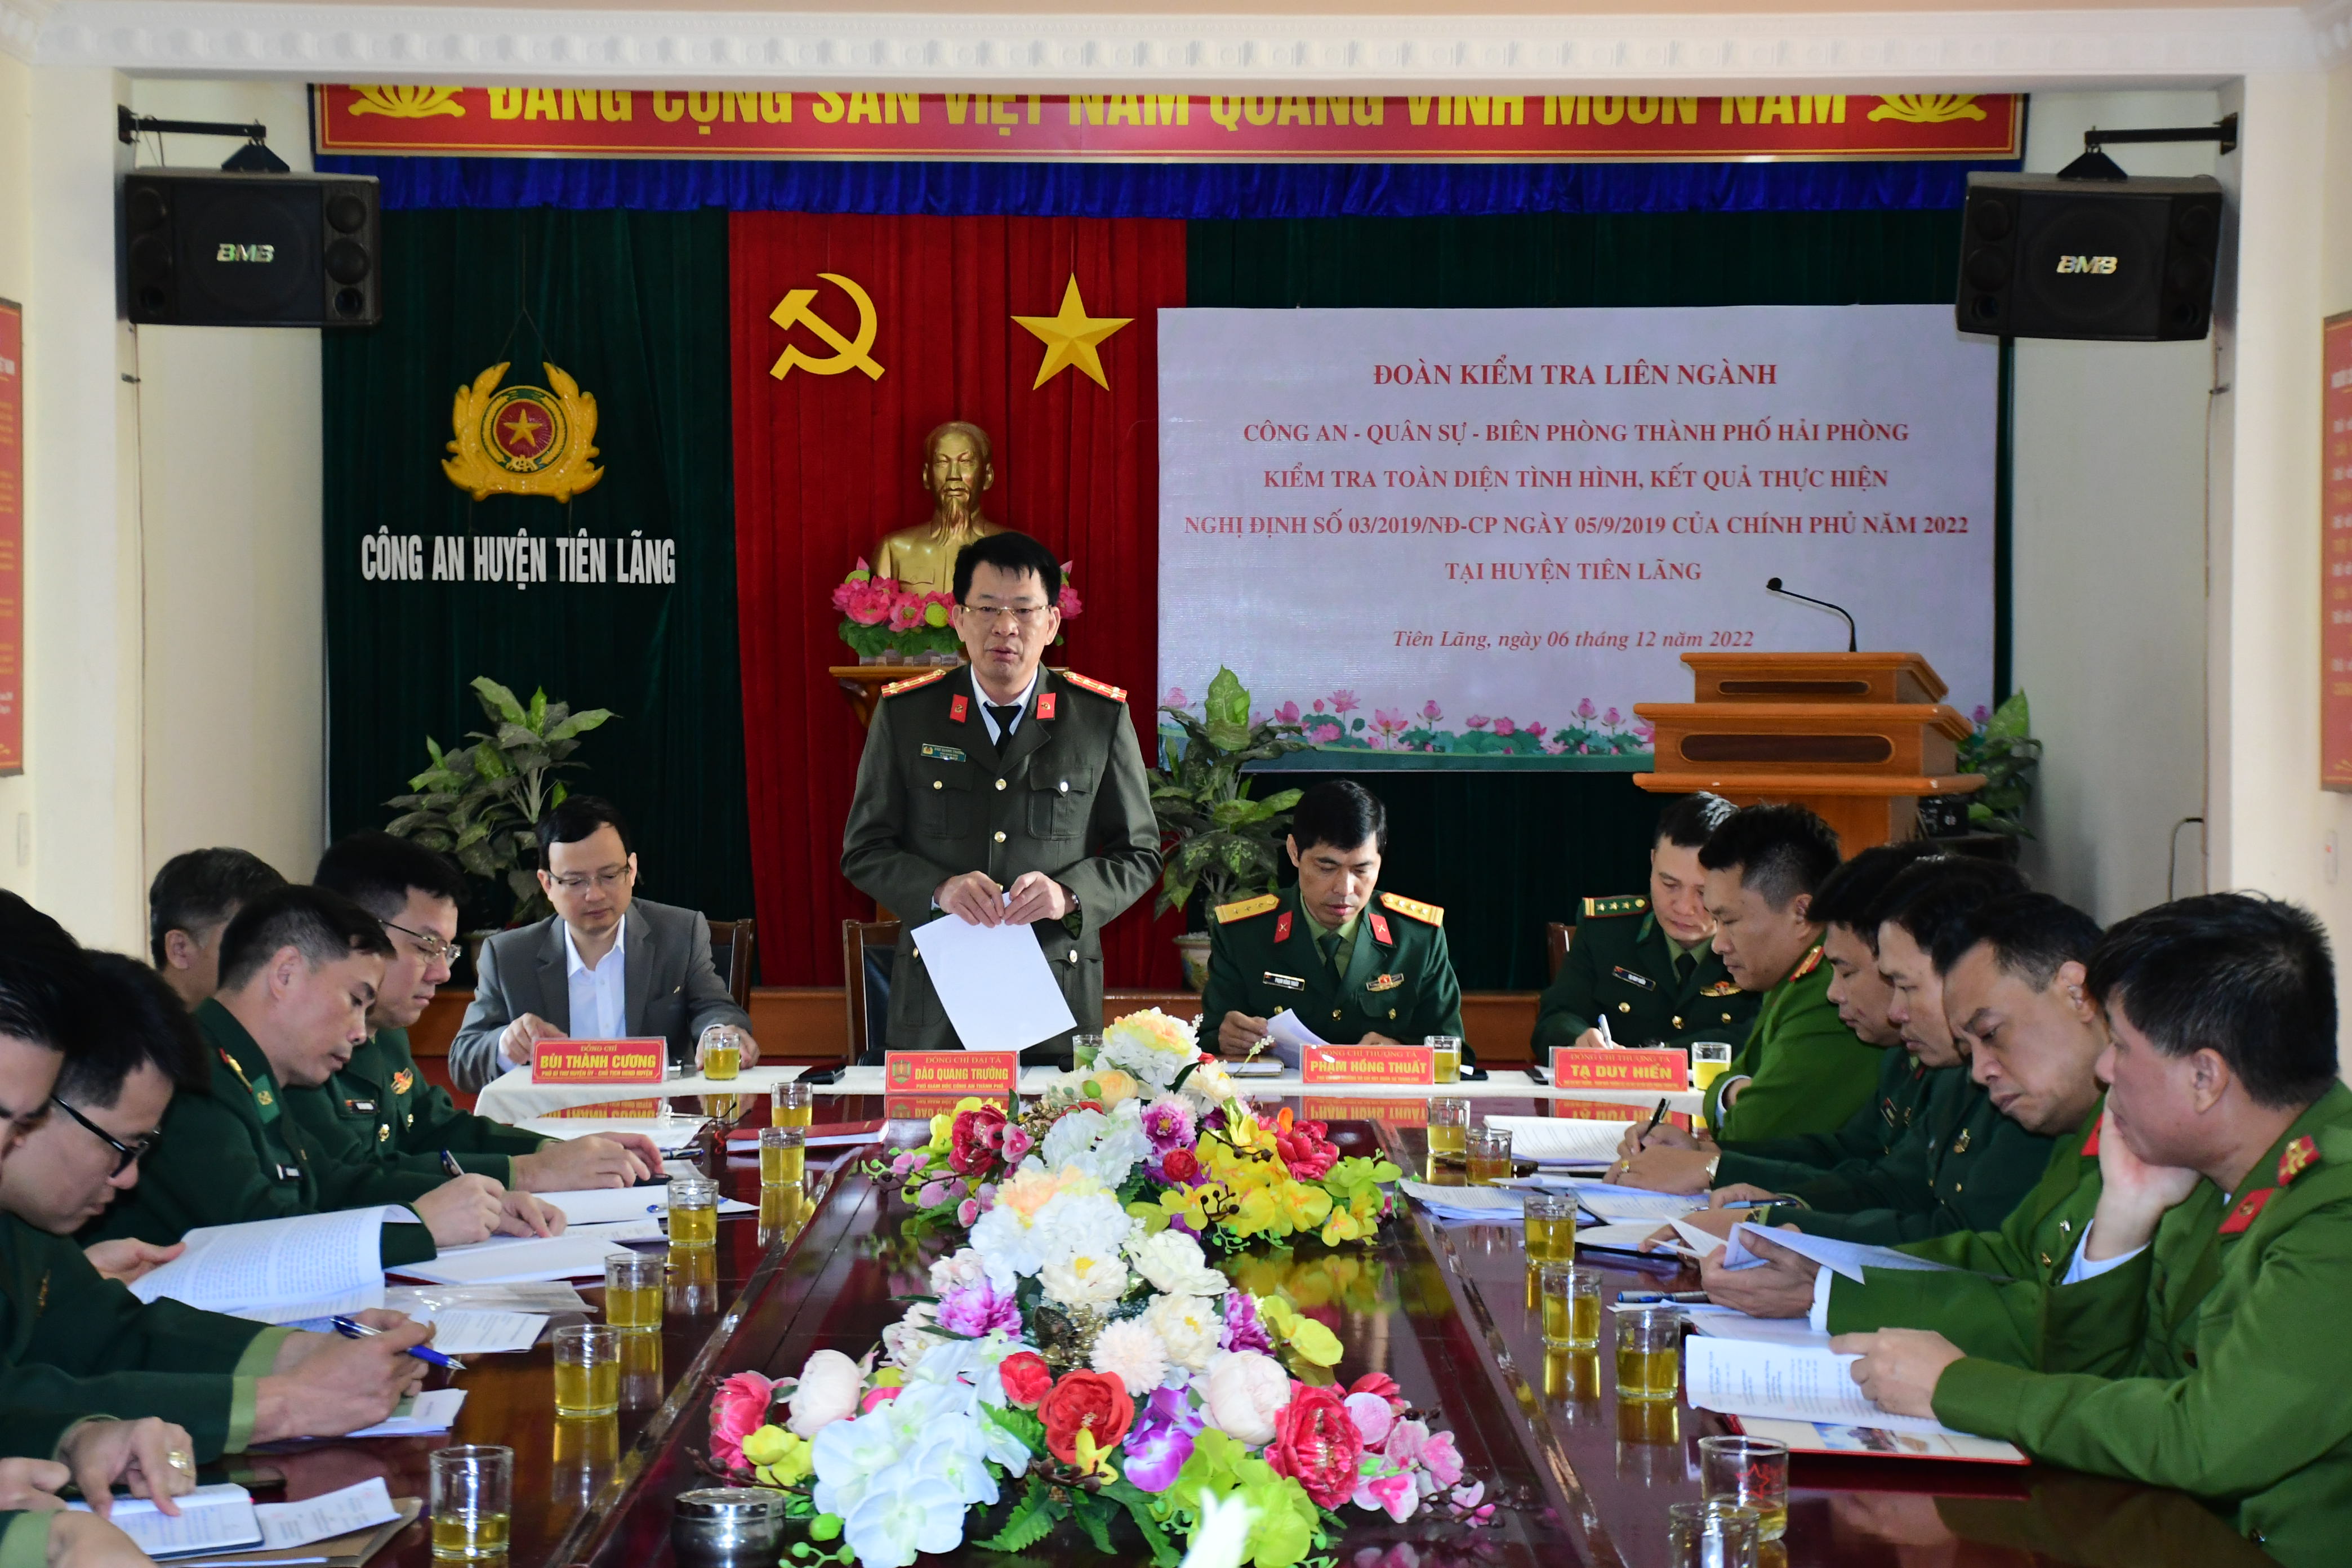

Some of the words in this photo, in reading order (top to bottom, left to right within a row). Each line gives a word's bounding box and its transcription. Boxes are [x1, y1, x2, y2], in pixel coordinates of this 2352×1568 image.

[217, 243, 275, 263] BMB
[2056, 255, 2118, 274] BMB
[1374, 359, 1452, 385] ĐOÀN
[1460, 354, 1533, 385] KIỂM
[1541, 364, 1596, 385] TRA
[1605, 359, 1669, 385] LIÊN
[1678, 359, 1777, 385] NGÀNH
[1244, 420, 1309, 442] CÔNG
[1316, 425, 1348, 442] AN
[1366, 420, 1432, 446] QUÂN
[1438, 421, 1468, 446] SỰ
[1486, 420, 1540, 442] BIÊN
[1547, 420, 1628, 442] PHÒNG
[1634, 420, 1716, 442] THÀNH
[1723, 416, 1772, 442] PHỐ
[1778, 418, 1820, 442] HẢI
[1827, 420, 1910, 442] PHÒNG
[1264, 462, 1325, 488] KIỂM
[1331, 471, 1377, 488] TRA
[1384, 466, 1447, 488] TOÀN
[1454, 466, 1509, 492] DIỆN
[1516, 466, 1573, 488] TÌNH
[1579, 466, 1644, 491] HÌNH,
[1651, 462, 1698, 488] KẾT
[1703, 465, 1753, 492] QUẢ
[1759, 467, 1824, 492] THỰC
[1830, 466, 1888, 492] HIỆN
[1185, 516, 1244, 538] NGHỊ
[1250, 516, 1307, 539] ĐỊNH
[1313, 509, 1343, 534] SỐ
[1348, 516, 1498, 534] 03/2019/NĐ-CP
[1504, 512, 1569, 534] NGÀY
[1575, 516, 1666, 534] 05/9/2019
[1672, 511, 1720, 534] CỦA
[1727, 511, 1803, 534] CHÍNH
[1810, 511, 1856, 534] PHỦ
[1863, 511, 1917, 534] NĂM
[1924, 516, 1970, 534] 2022
[362, 525, 424, 581] CÔNG
[432, 536, 465, 581] AN
[474, 528, 547, 590] HUYỆN
[556, 528, 607, 583] TIÊN
[617, 529, 676, 584] LÃNG
[1445, 563, 1485, 585] TẠI
[1491, 559, 1571, 585] HUYỆN
[1577, 559, 1632, 581] TIÊN
[1638, 559, 1702, 581] LÃNG
[1394, 630, 1434, 647] Tiên
[1441, 630, 1492, 651] Lãng,
[1498, 631, 1542, 651] ngày
[1547, 631, 1570, 647] 06
[1576, 631, 1630, 651] tháng
[1636, 631, 1657, 647] 12
[1663, 632, 1703, 647] năm
[1710, 631, 1755, 647] 2022
[937, 1068, 968, 1081] QUANG
[1596, 1066, 1627, 1078] DUY
